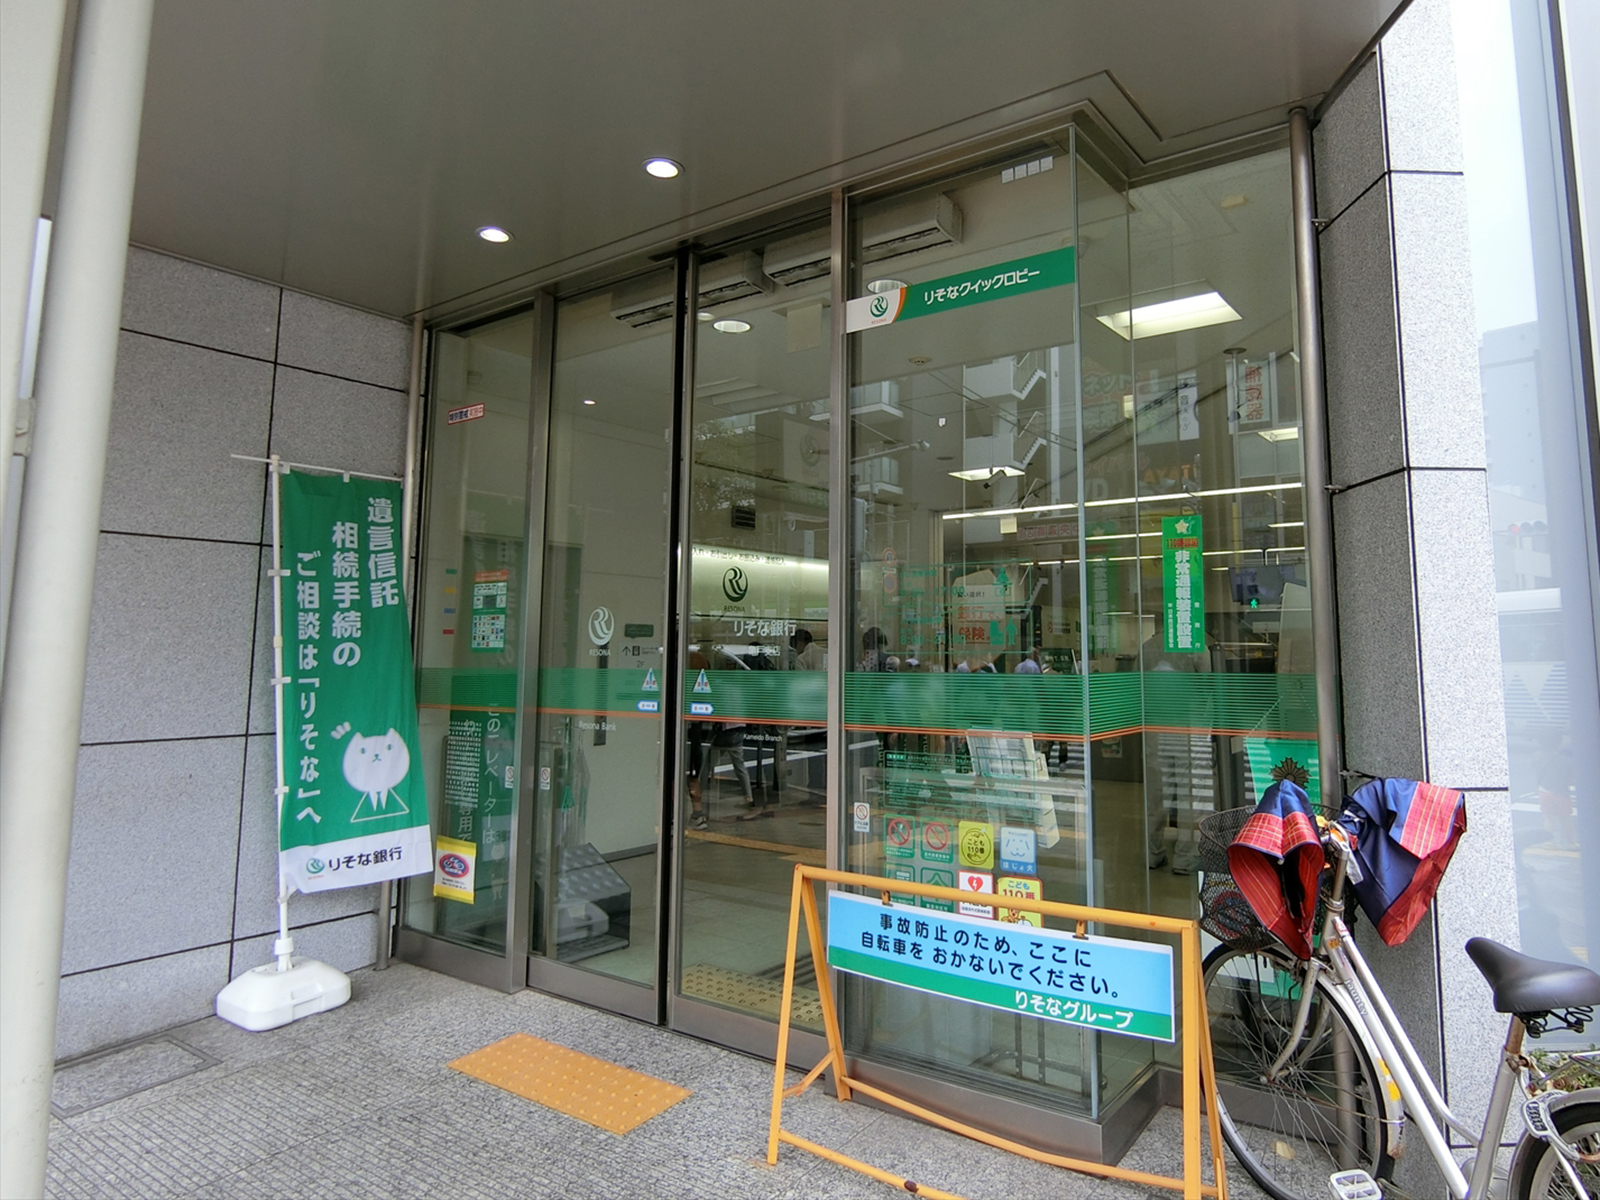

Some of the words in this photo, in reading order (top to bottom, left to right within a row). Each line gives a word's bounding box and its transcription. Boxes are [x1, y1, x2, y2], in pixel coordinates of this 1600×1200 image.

[924, 268, 1040, 305] りそなクイックロビー
[367, 497, 399, 608] 遺言信託
[331, 521, 361, 667] 相続手続の
[1175, 550, 1192, 648] 非常通報装置設置
[734, 619, 798, 637] りそな銀行
[589, 648, 612, 657] RESONA
[296, 550, 322, 824] ご相談は「りそな」へ
[579, 720, 600, 731] Resona
[601, 722, 617, 732] Bank
[765, 734, 783, 742] Branch
[967, 838, 985, 846] こども
[967, 846, 985, 854] 110番
[328, 846, 403, 872] りそな銀行
[1002, 861, 1034, 872] ほじょ犬
[1008, 880, 1030, 890] こども
[880, 913, 1092, 968] 事故防止のため、ここに
[1015, 990, 1134, 1028] りそなグループ
